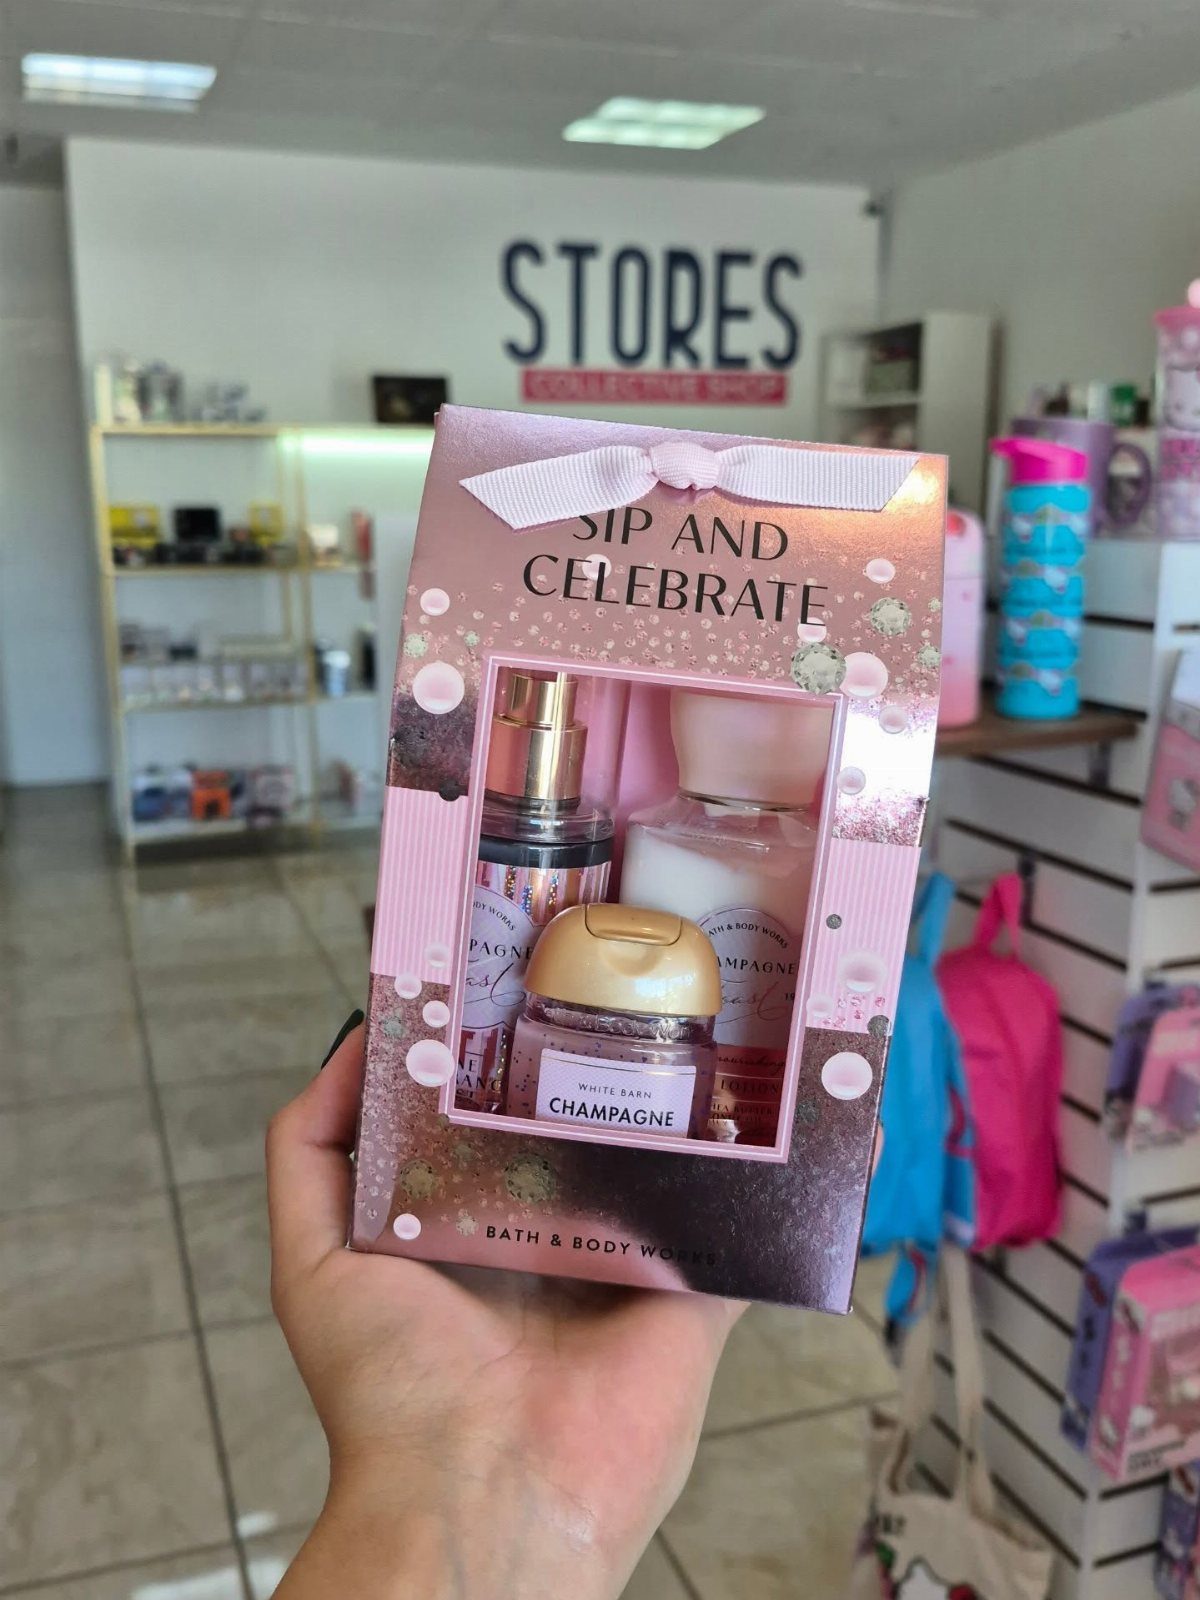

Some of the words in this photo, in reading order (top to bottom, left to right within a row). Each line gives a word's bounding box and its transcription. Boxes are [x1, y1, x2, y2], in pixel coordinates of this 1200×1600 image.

[501, 239, 804, 370] STORES
[572, 506, 653, 545] SIP
[671, 513, 789, 561] AND
[522, 554, 829, 627] CELEBRATE
[489, 906, 516, 931] WORKS
[726, 923, 733, 931] &
[735, 922, 760, 932] BODY
[761, 926, 789, 949] WORKS
[578, 1083, 615, 1096] WHITE
[621, 1088, 652, 1099] BARN
[549, 1097, 674, 1127] CHAMPAGNE
[486, 1225, 539, 1244] BATH
[550, 1234, 561, 1246] &
[573, 1237, 631, 1255] BODY
[640, 1244, 716, 1266] WORKS
